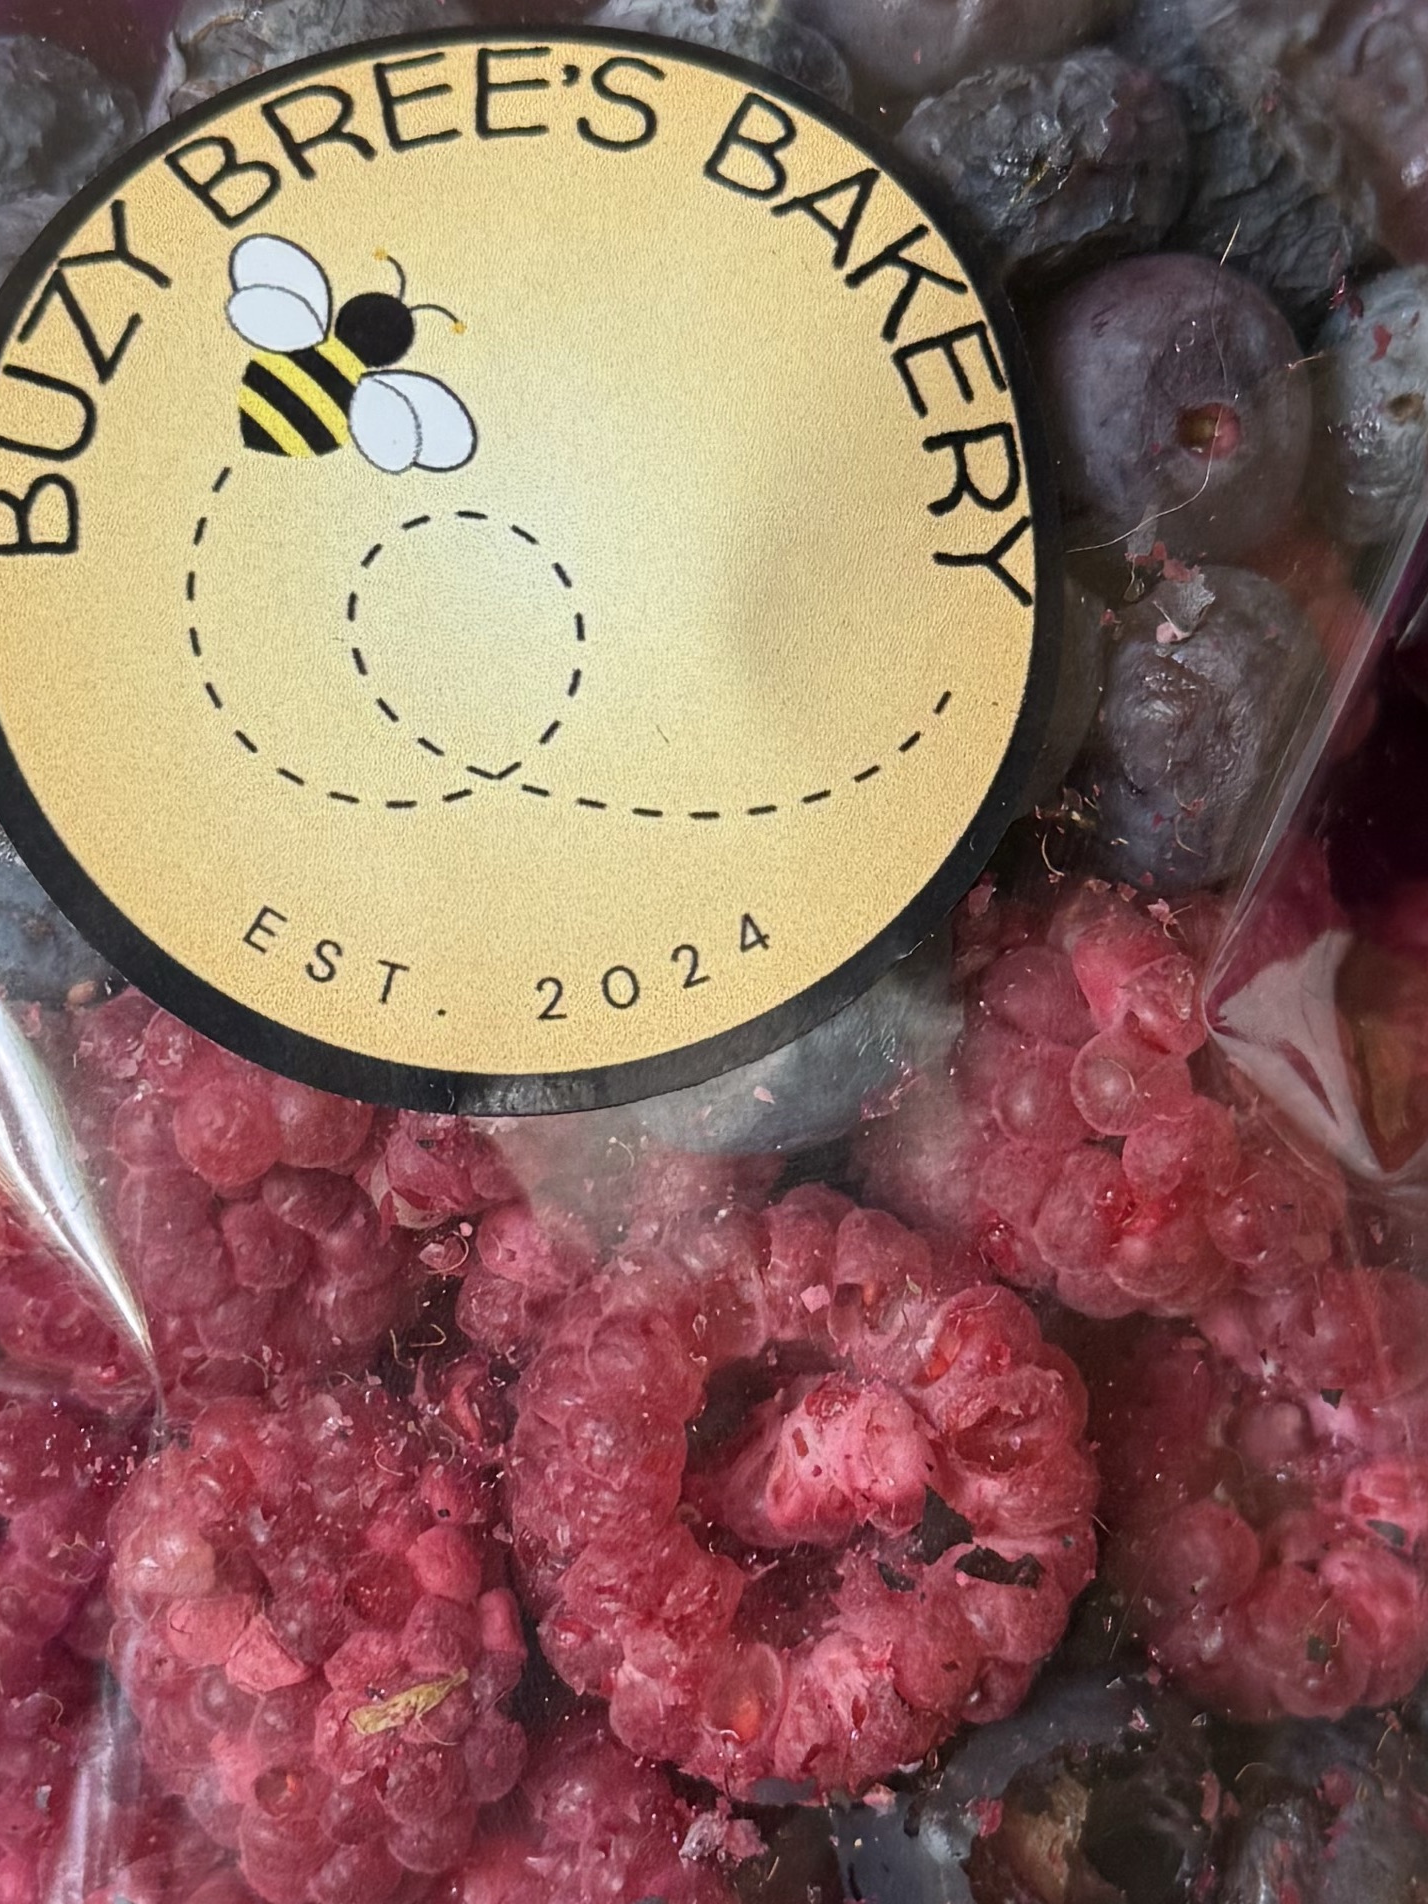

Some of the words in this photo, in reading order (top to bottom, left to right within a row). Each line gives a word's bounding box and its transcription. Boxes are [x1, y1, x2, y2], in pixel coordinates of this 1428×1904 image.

[164, 45, 665, 228] BREE'S
[704, 93, 1034, 609] BAKERY
[241, 905, 449, 1018] EST.
[535, 912, 772, 1021] 2024
